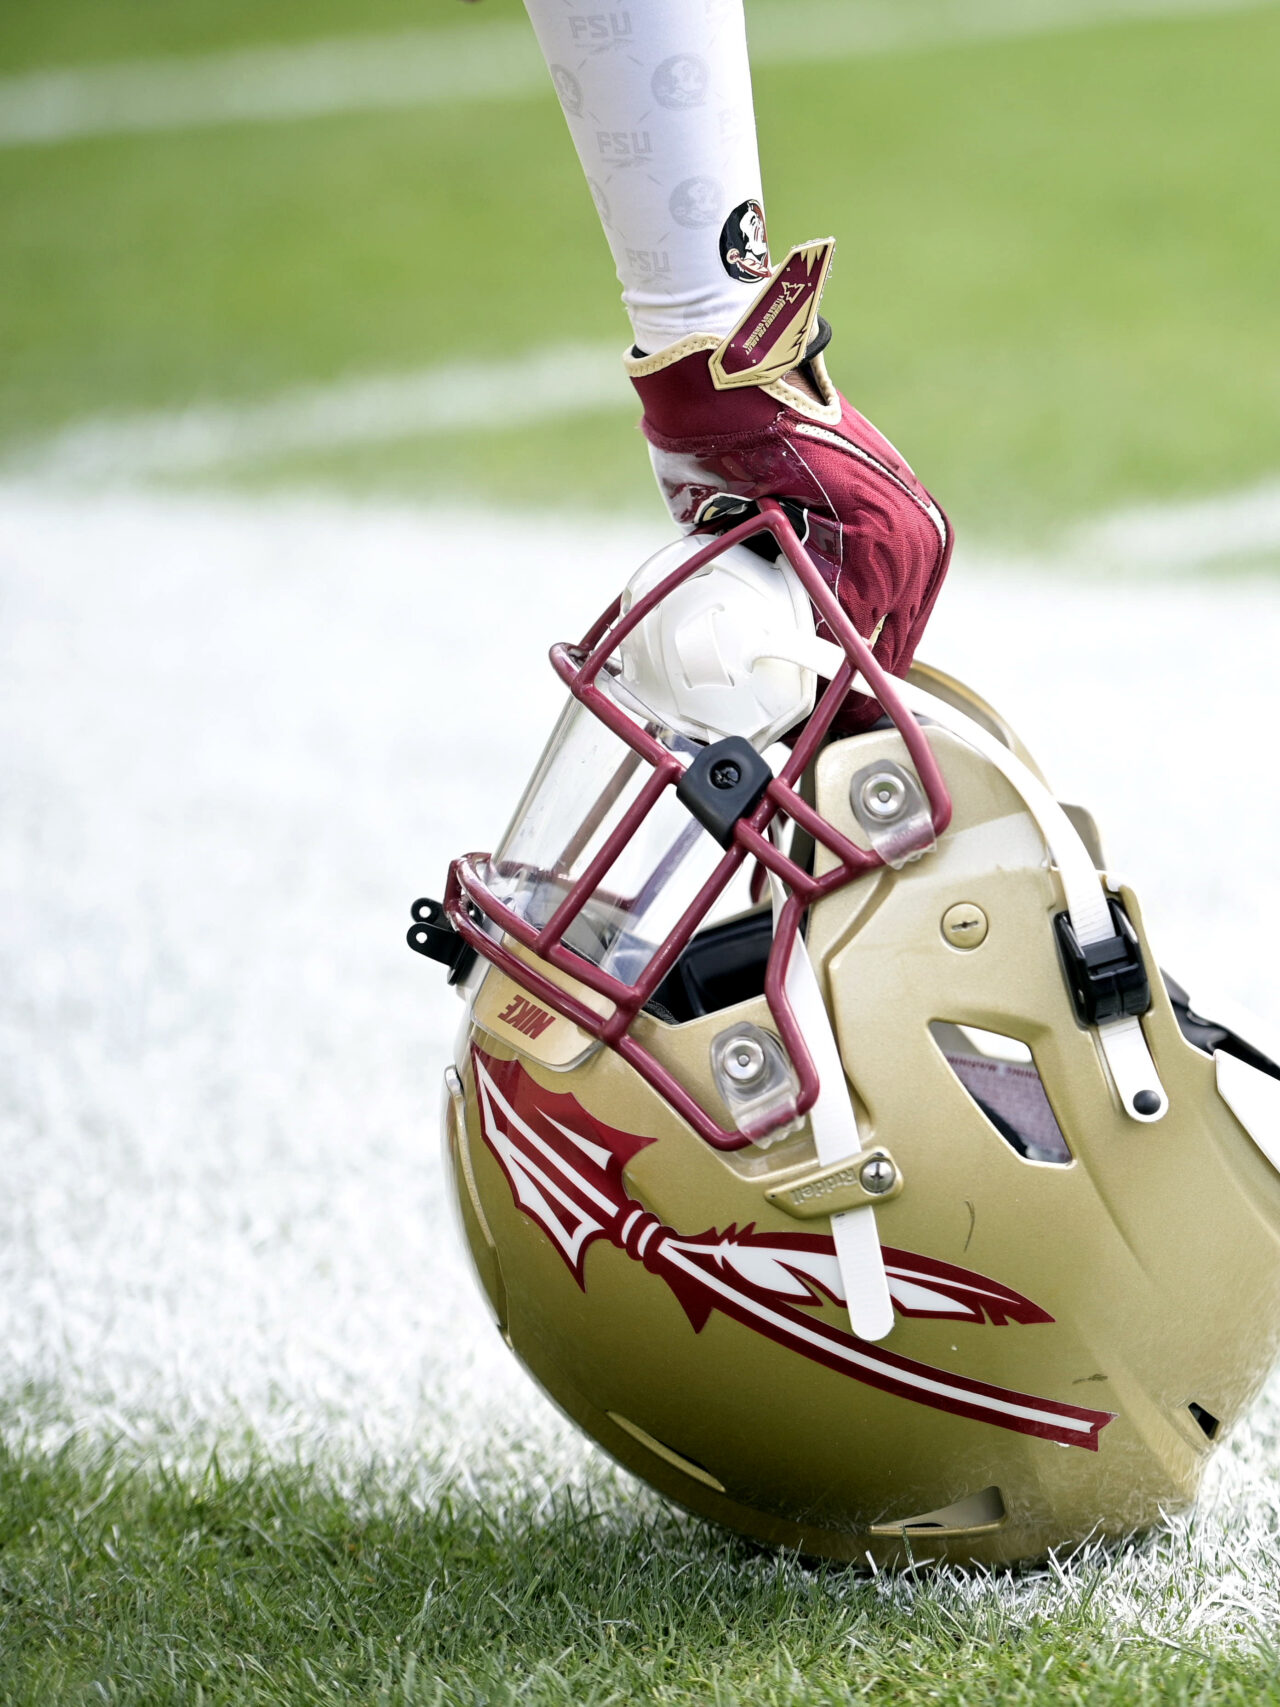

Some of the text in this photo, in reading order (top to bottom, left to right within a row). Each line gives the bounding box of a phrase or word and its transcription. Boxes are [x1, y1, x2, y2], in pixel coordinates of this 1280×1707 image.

[568, 11, 633, 39] FSU
[597, 131, 653, 154] FSU
[628, 249, 670, 273] FSU
[498, 994, 556, 1040] NIKE
[790, 1168, 859, 1205] Riddell
